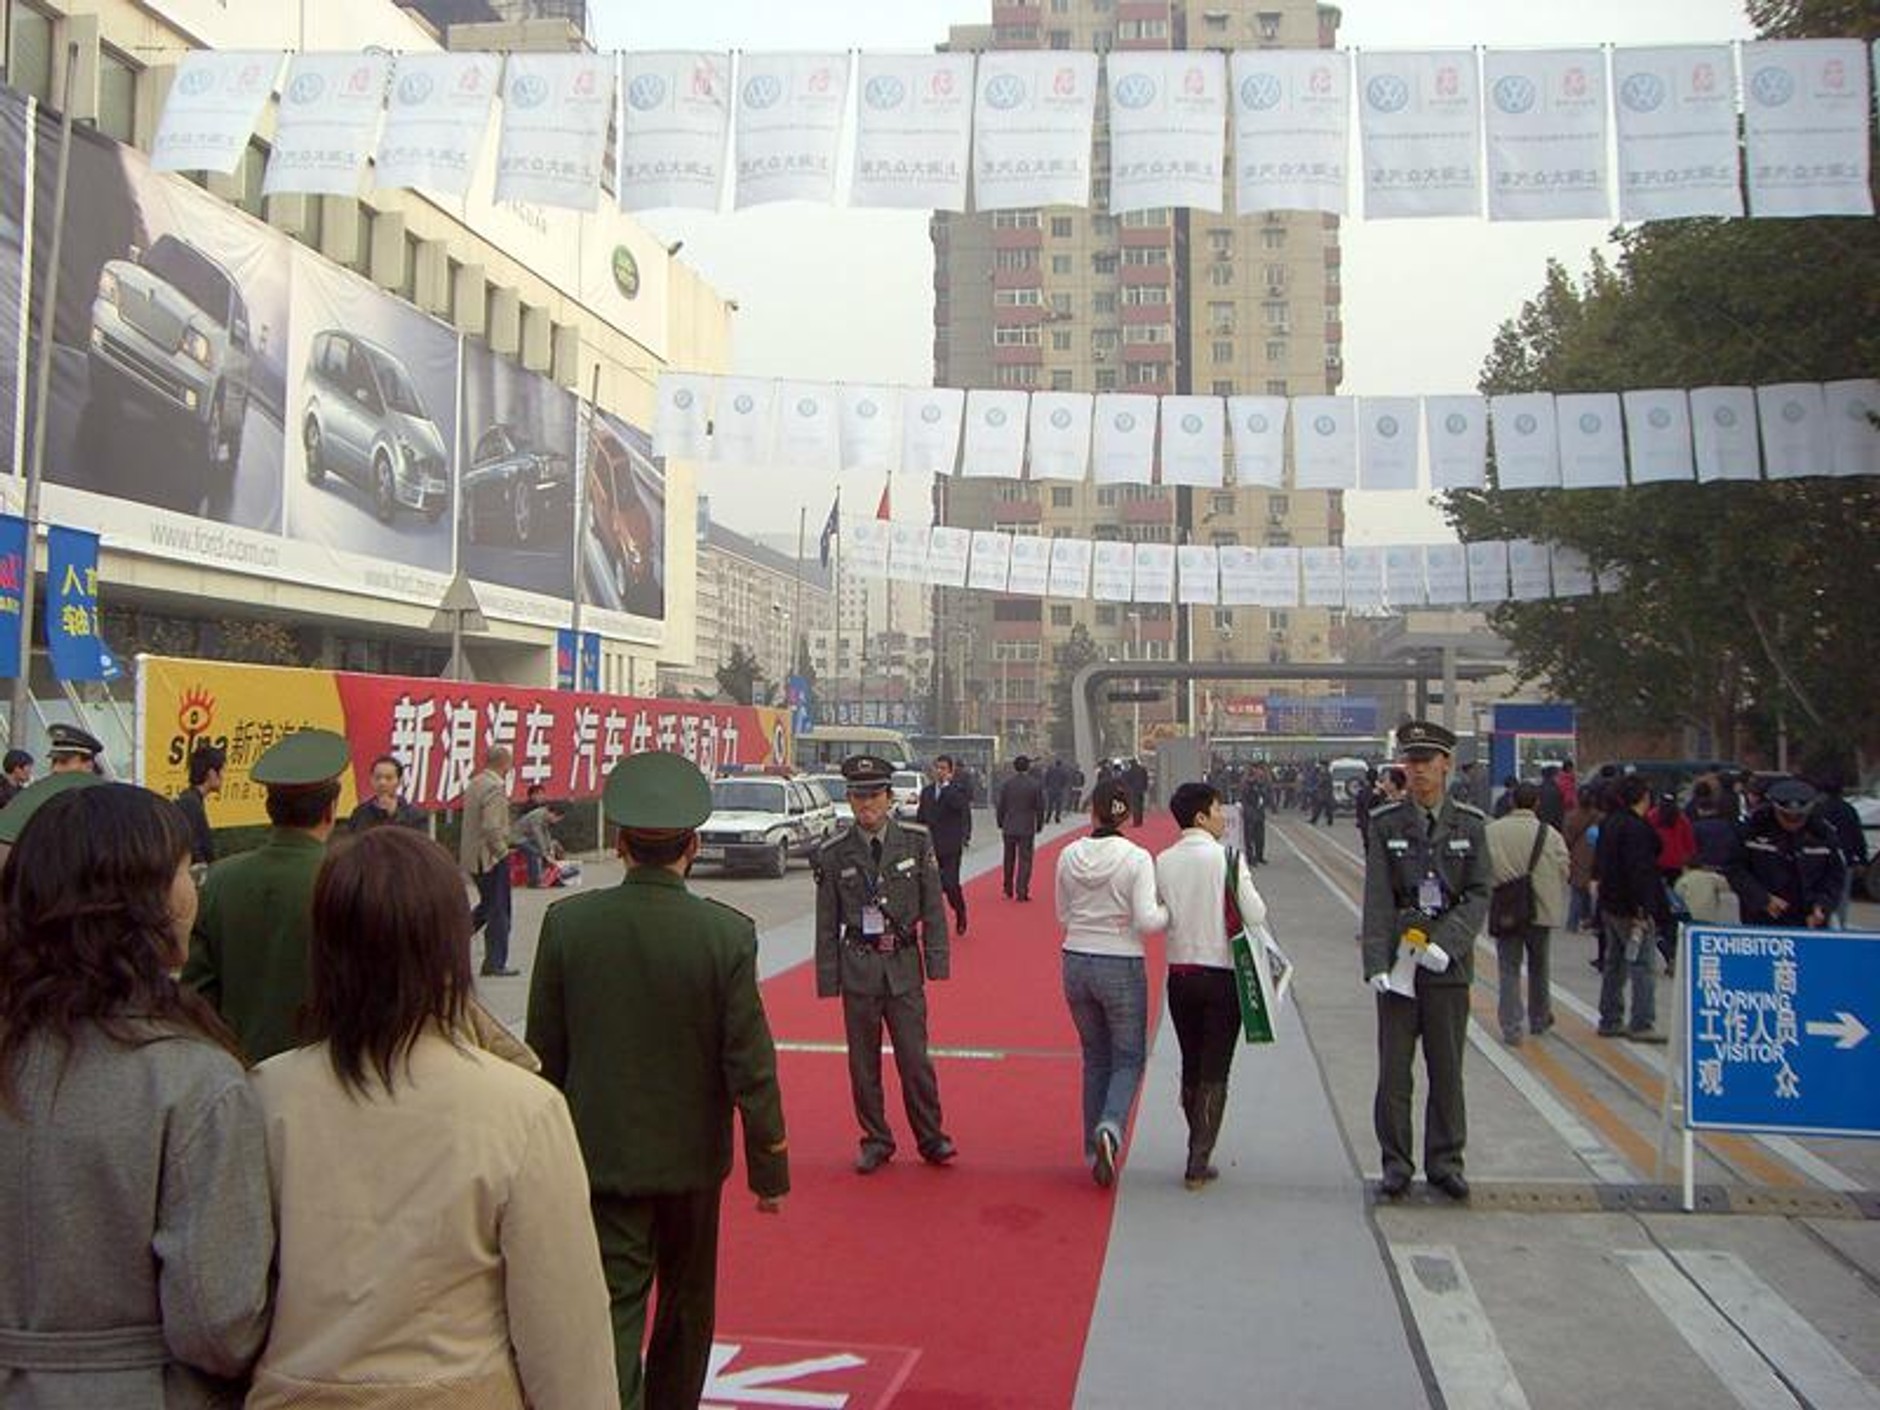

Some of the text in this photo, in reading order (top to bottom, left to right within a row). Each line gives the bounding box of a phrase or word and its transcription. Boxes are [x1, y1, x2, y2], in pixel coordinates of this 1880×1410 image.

[391, 694, 555, 804] 新浪汽车
[1700, 935, 1796, 957] EXHIBITOR
[1704, 988, 1792, 1011] WORKING
[1698, 1006, 1799, 1047] 工作人员
[1713, 1043, 1786, 1063] VISITOR
